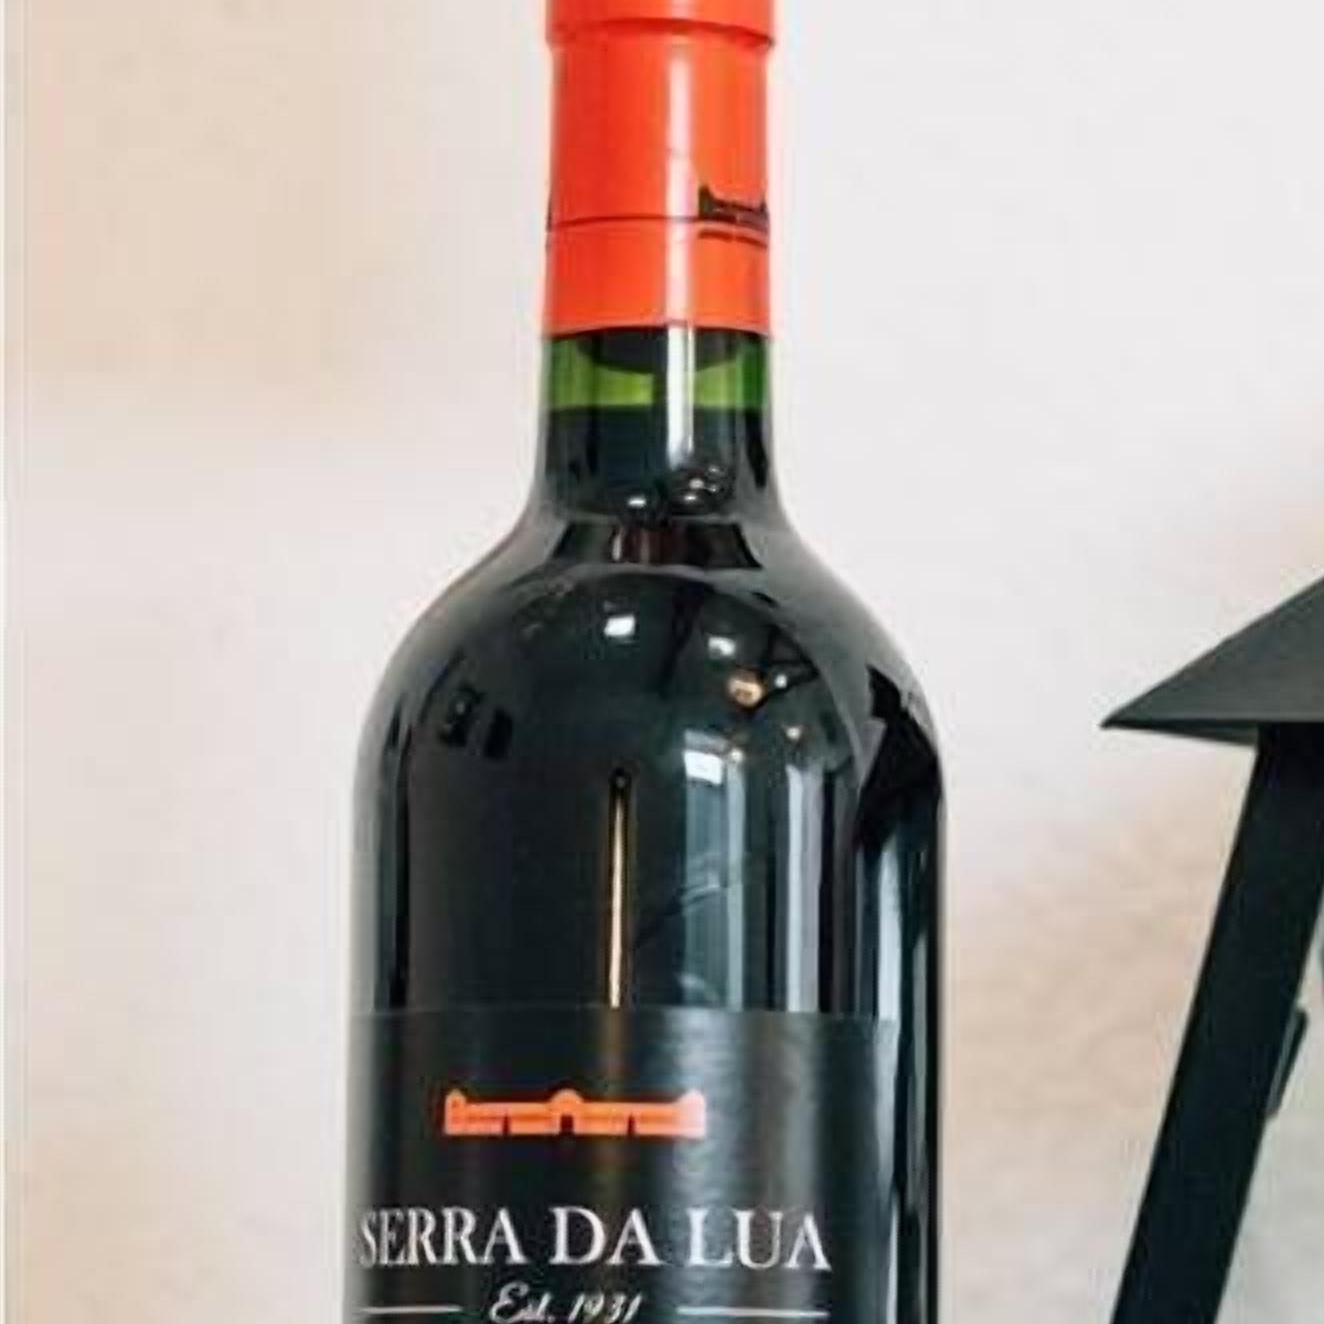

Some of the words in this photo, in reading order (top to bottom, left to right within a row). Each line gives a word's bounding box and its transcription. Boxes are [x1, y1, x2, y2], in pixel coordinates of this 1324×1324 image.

[359, 1206, 529, 1268] SERRA
[549, 1205, 661, 1267] DA
[686, 1206, 833, 1273] LUA
